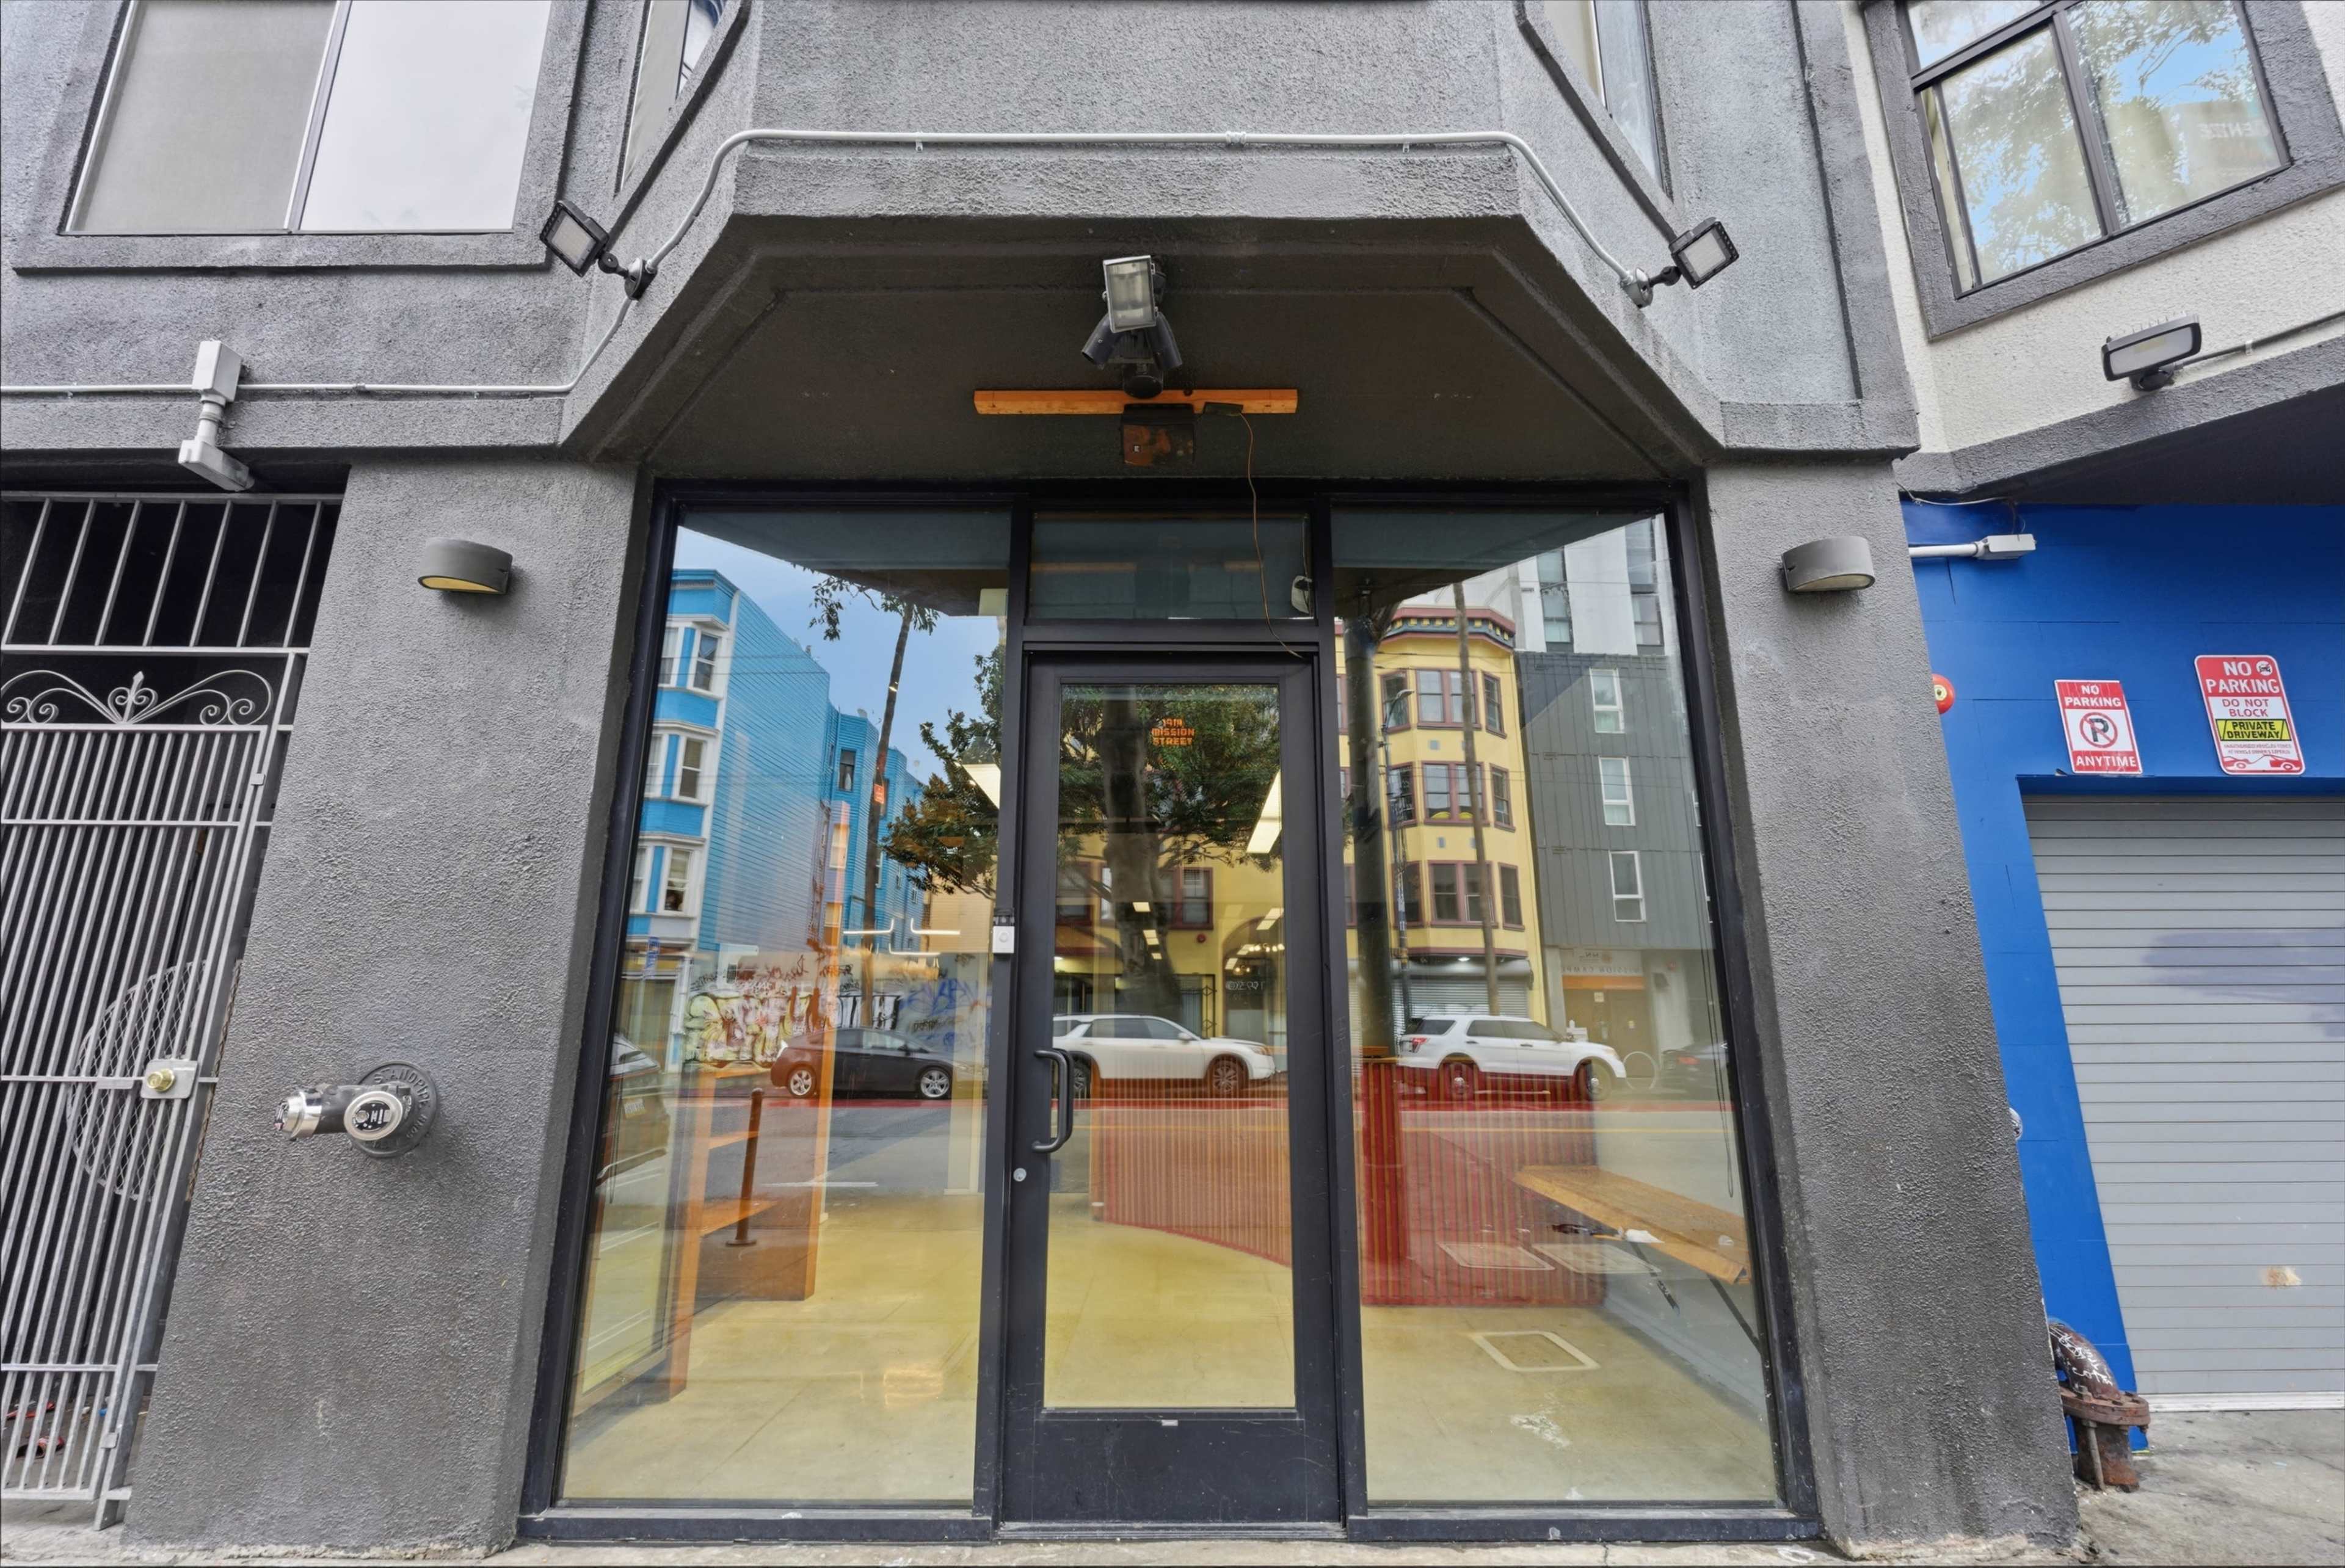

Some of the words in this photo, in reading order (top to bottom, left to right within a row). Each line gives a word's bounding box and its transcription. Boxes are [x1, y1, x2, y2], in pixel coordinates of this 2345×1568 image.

[2223, 661, 2252, 676] NO
[2081, 684, 2100, 695] NO
[2205, 679, 2280, 694] PARKING
[2064, 697, 2121, 707] PARKING
[2222, 699, 2239, 707] DO
[2244, 699, 2269, 707] NOT
[2089, 718, 2109, 742] P
[2231, 722, 2276, 730] PRIVATE
[1152, 728, 1195, 736] MISSION
[2076, 756, 2136, 767] ANYTIME
